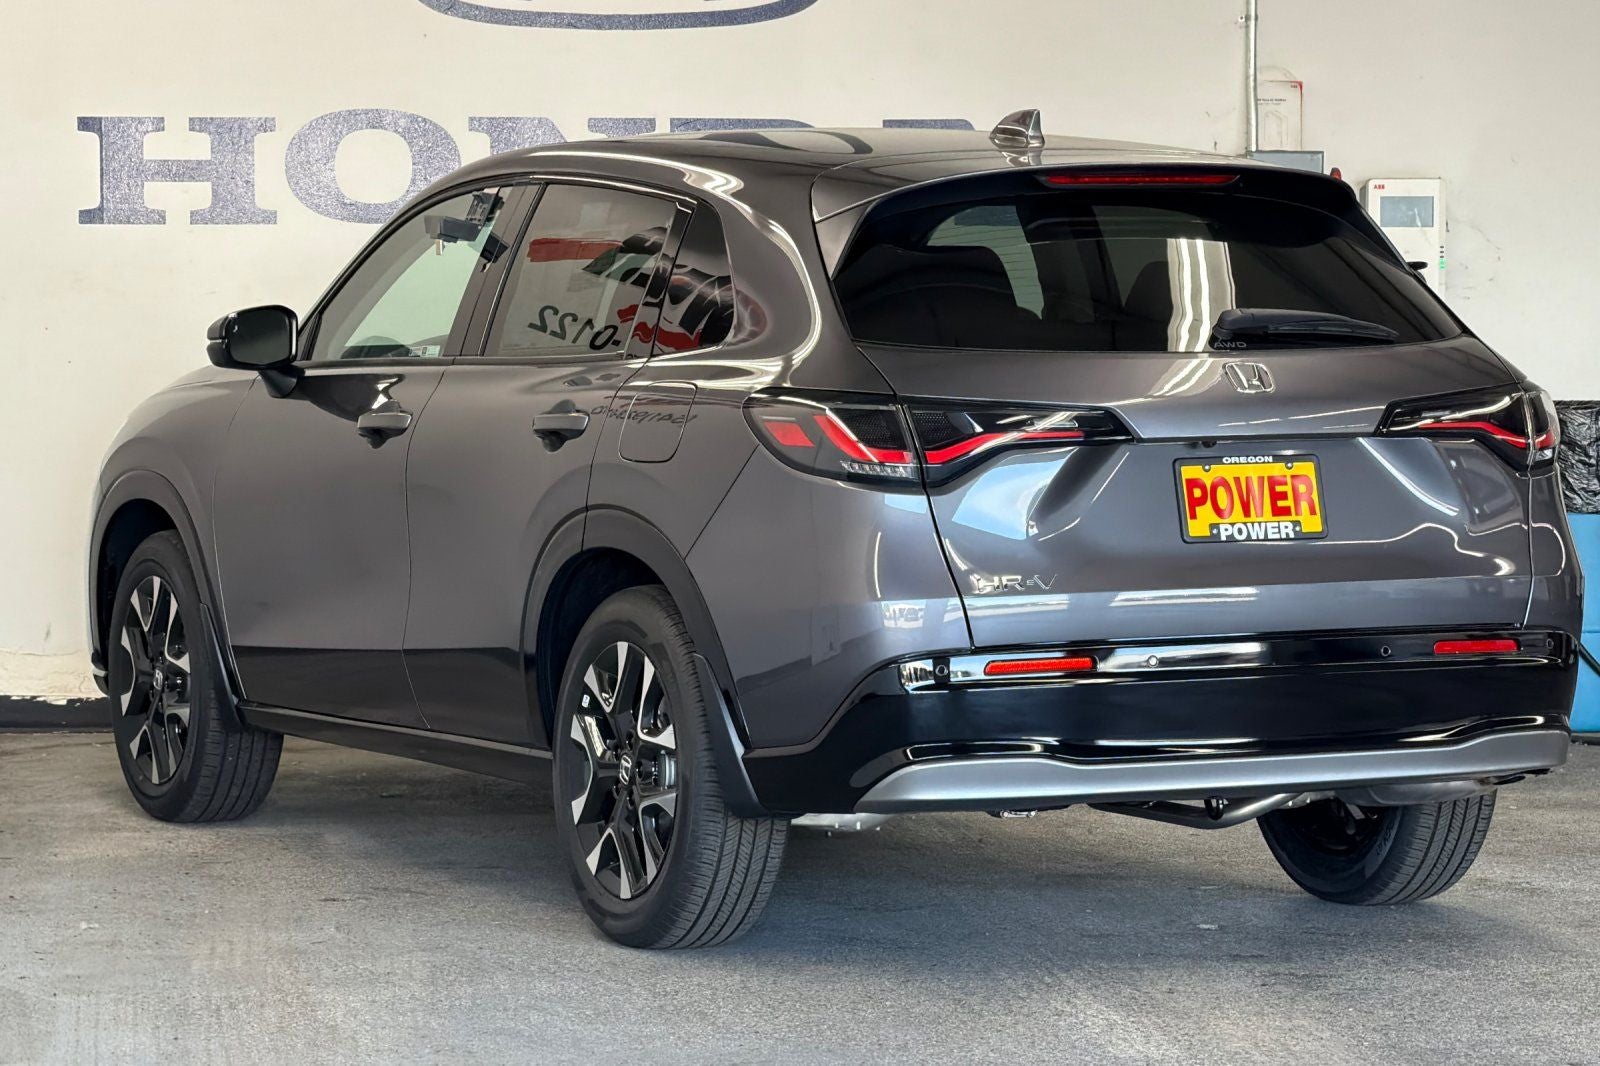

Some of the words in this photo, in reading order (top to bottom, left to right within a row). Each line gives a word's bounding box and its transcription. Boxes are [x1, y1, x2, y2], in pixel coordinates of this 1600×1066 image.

[1213, 341, 1247, 349] AWD
[1222, 455, 1274, 464] OREGON
[1184, 474, 1318, 521] POWER
[1219, 521, 1295, 541] POWER
[973, 574, 1057, 592] HR-V
